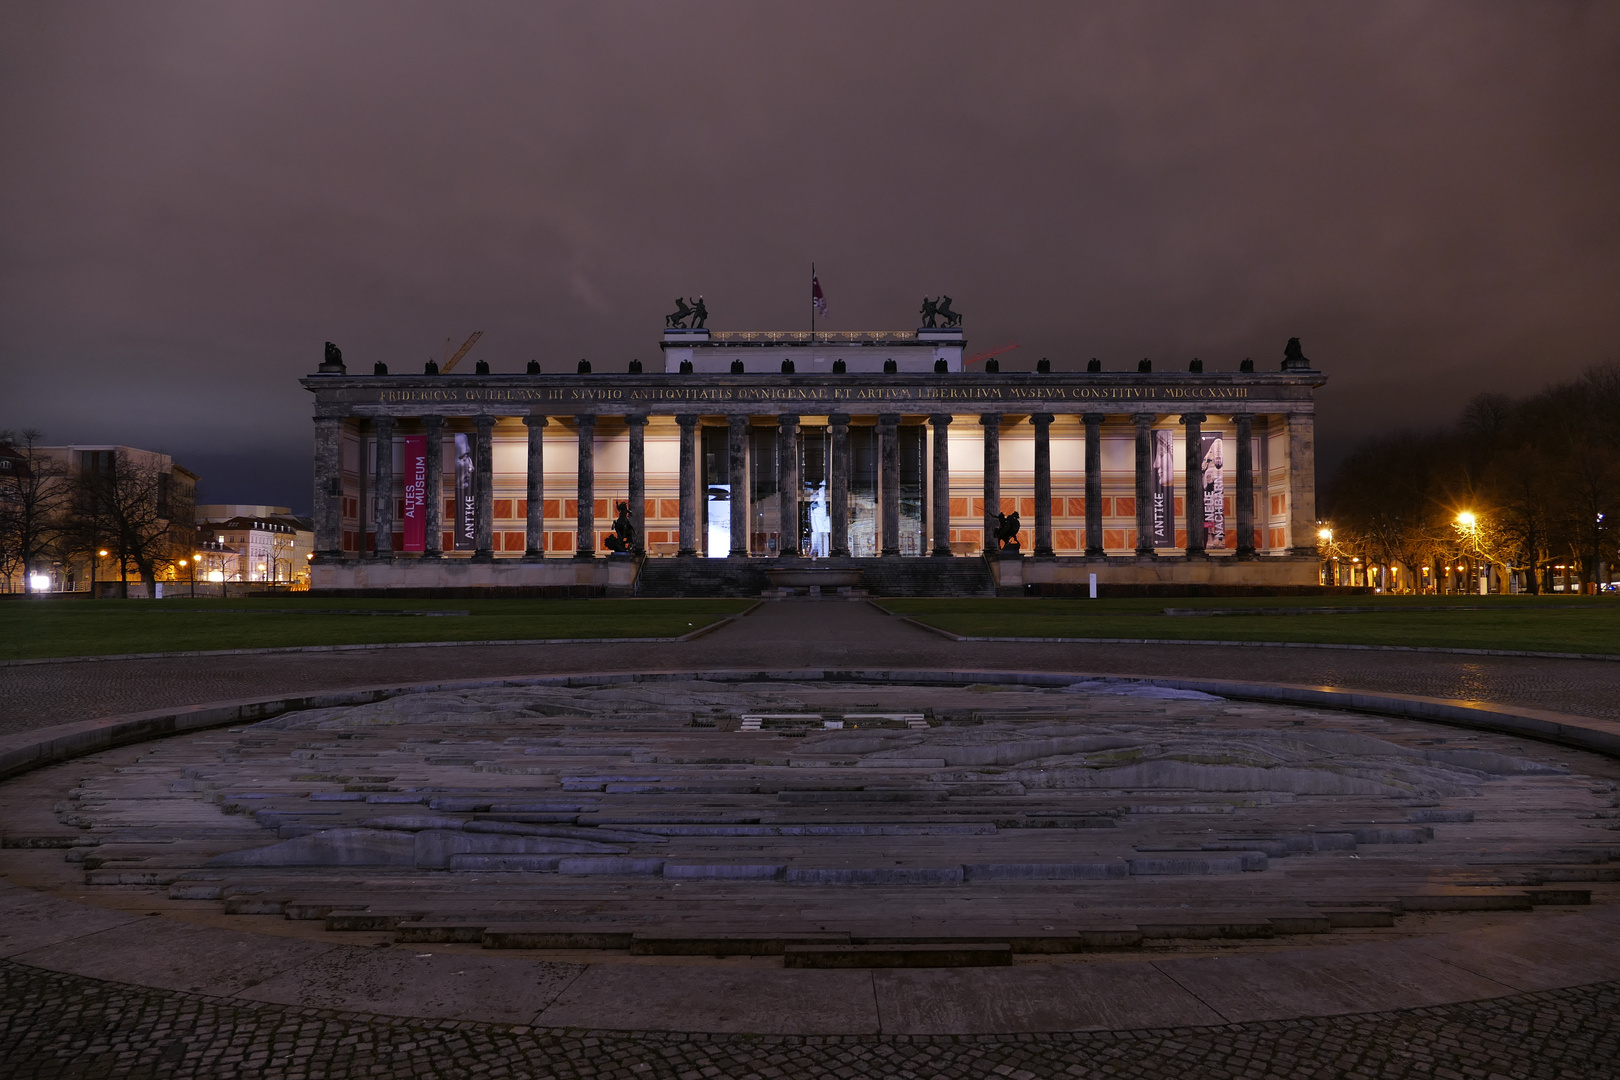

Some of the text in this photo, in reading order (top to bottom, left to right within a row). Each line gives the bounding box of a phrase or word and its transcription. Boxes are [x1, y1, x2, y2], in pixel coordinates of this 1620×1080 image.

[380, 388, 1248, 400] FRIDERICVS GVILELMVS III STVDIO ANTIQVITATIS OMNIGENAE ET ARTIVM LIBERALIVM MVSEVM CONSTITVIT MDCCCXXVIII
[405, 485, 415, 518] ALTES
[415, 456, 425, 506] MUSEUM
[465, 495, 475, 539] ANTIKE
[1154, 492, 1164, 537] ANTIKE
[1204, 490, 1215, 521] NEUE
[1214, 476, 1225, 539] NACHBARN
